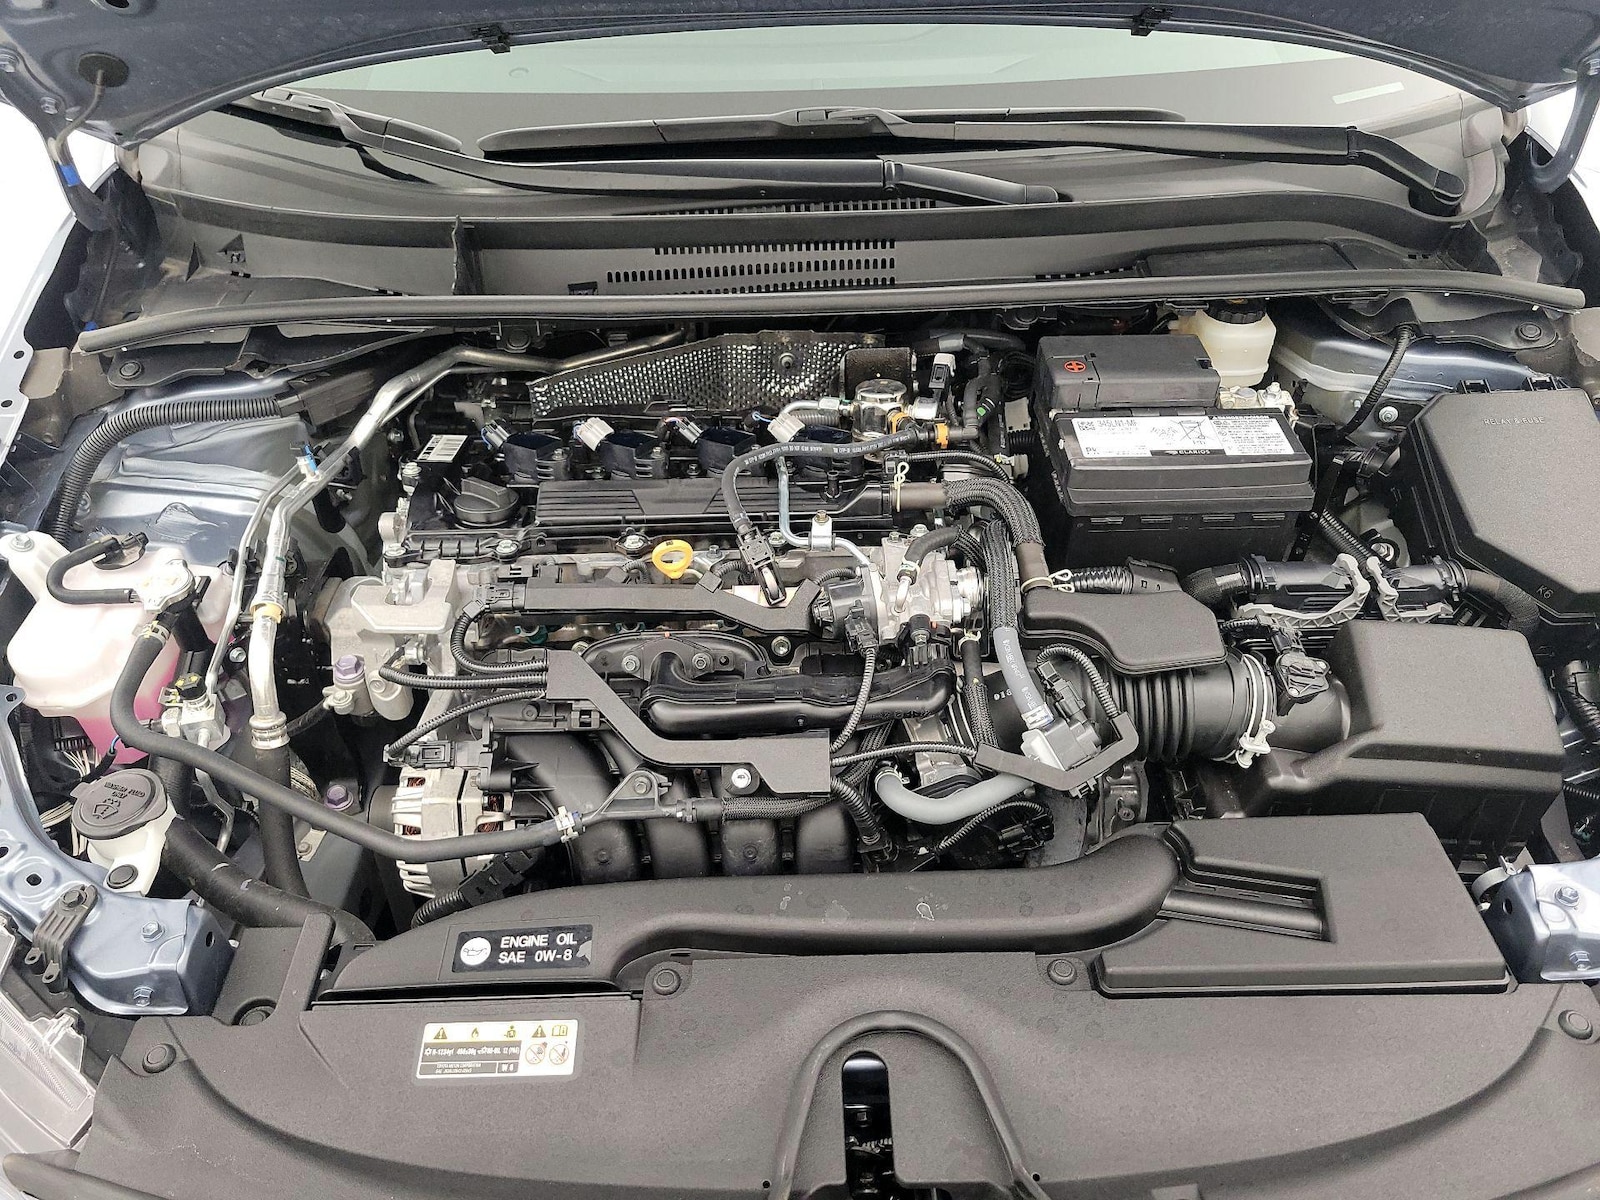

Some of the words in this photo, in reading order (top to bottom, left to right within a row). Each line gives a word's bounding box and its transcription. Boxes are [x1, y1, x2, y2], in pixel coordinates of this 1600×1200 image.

[1536, 585, 1554, 599] K6
[500, 934, 549, 949] ENGINE
[556, 932, 578, 945] OIL
[498, 951, 526, 963] SAE
[534, 949, 572, 962] 0W-8
